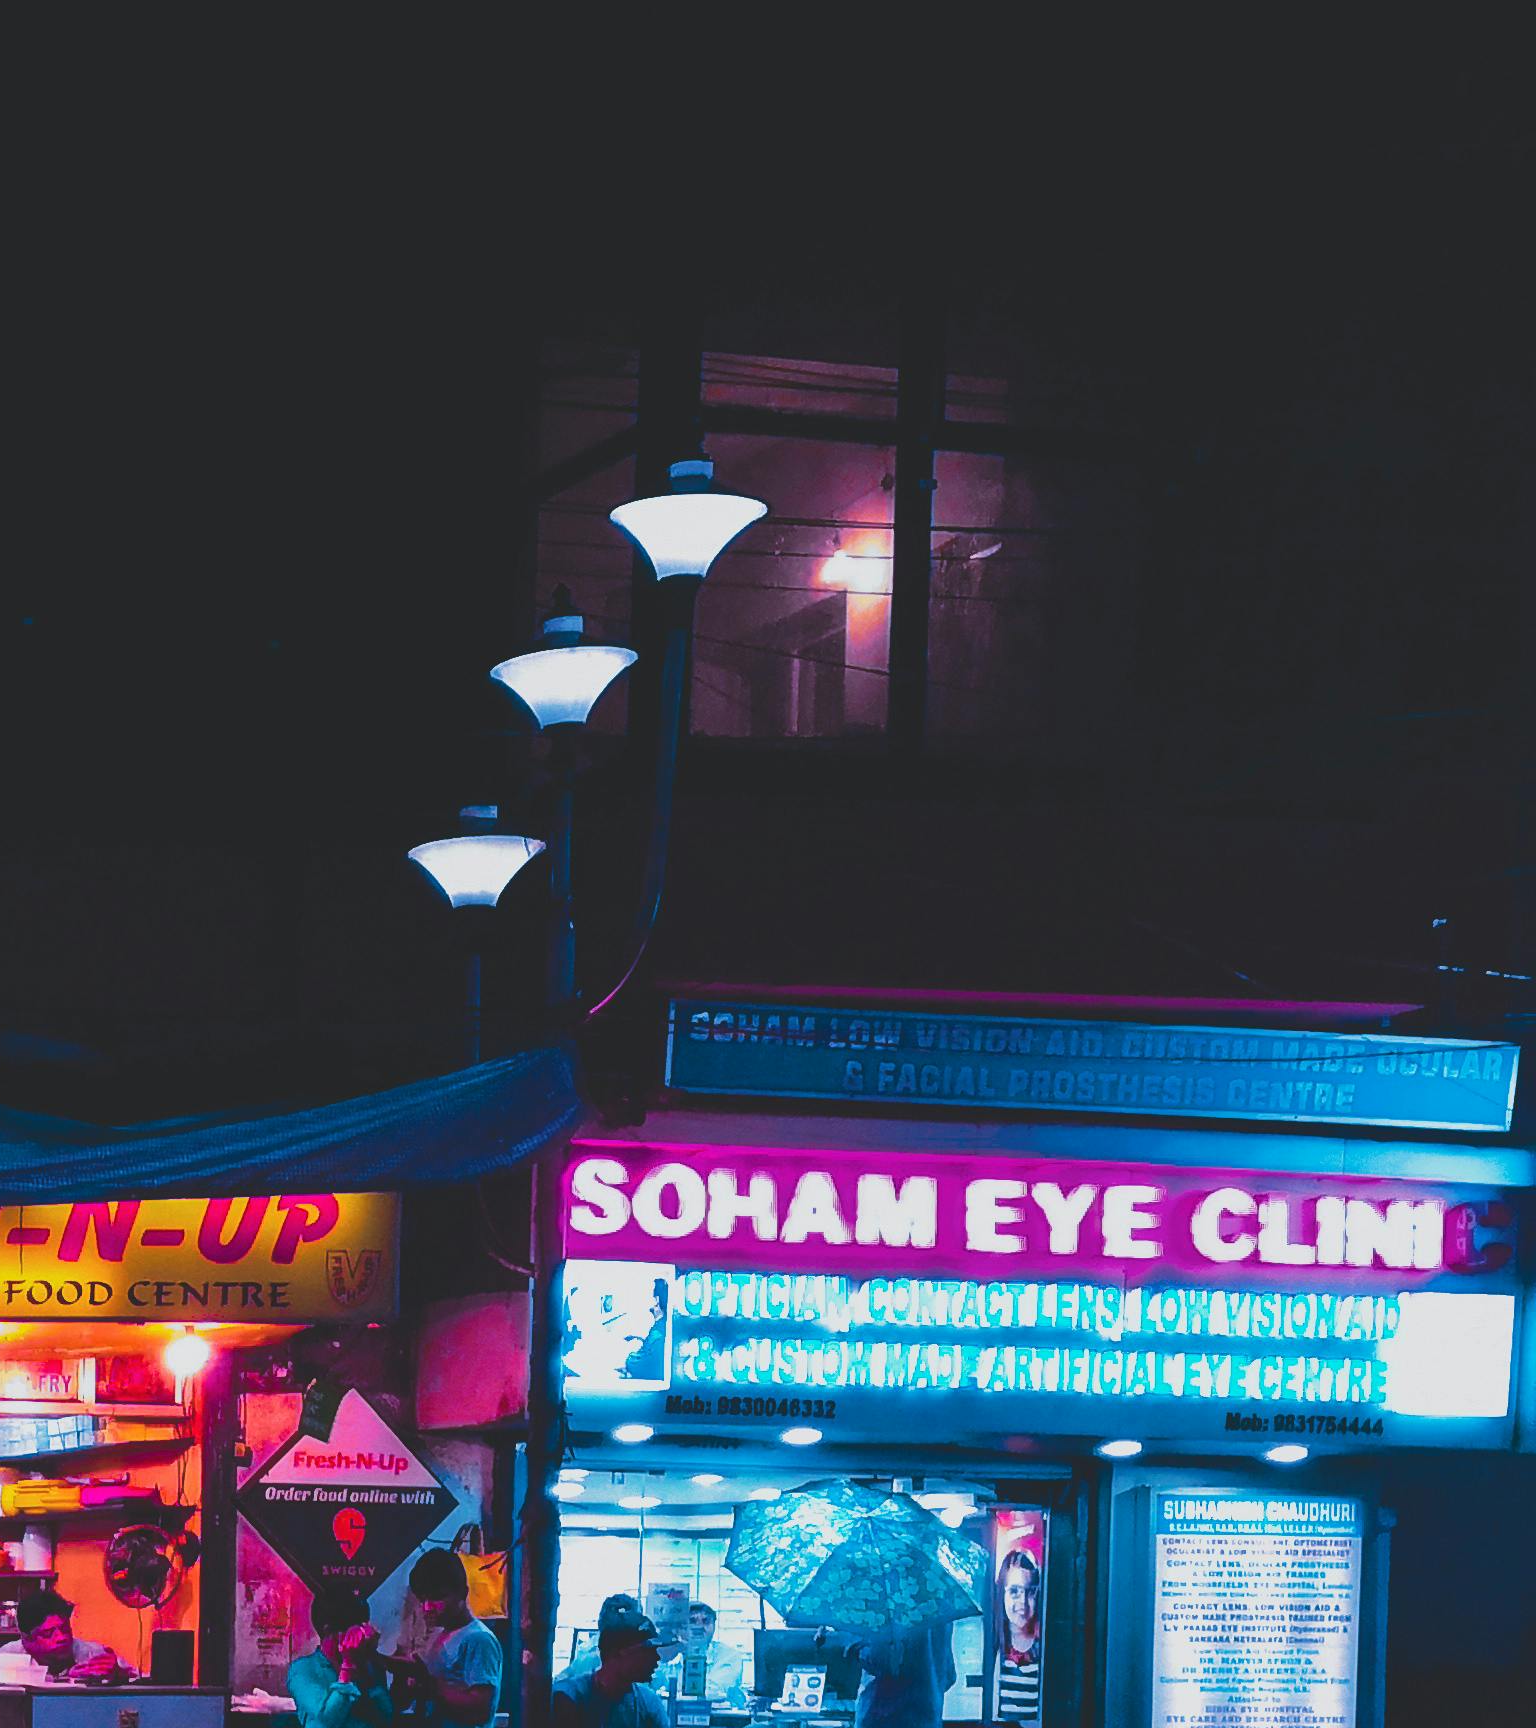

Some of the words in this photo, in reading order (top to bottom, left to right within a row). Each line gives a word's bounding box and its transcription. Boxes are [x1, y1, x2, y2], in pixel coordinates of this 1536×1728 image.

[690, 1011, 816, 1047] SOHAM
[829, 1018, 903, 1051] LOW
[917, 1023, 1033, 1055] VISION
[1272, 1040, 1366, 1074] MADE
[1375, 1047, 1503, 1081] OCULAR
[878, 1062, 996, 1098] FACIAL
[1008, 1068, 1214, 1105] PROSTHESIS
[1227, 1079, 1356, 1113] CENTRE
[569, 1158, 939, 1249] SOHAM
[965, 1178, 1166, 1260] EYE
[4, 1277, 113, 1308] FOOD
[128, 1279, 291, 1310] CENTRE
[866, 1278, 1027, 1327] CONTACT
[1136, 1288, 1211, 1335] LOW
[1223, 1291, 1340, 1338] VISION
[1344, 1295, 1402, 1341] AID
[690, 1336, 715, 1382] &
[732, 1338, 876, 1386] CUSTOM
[883, 1343, 981, 1390] MADE
[988, 1347, 1171, 1396] ARTIFICIAL
[1182, 1354, 1245, 1400] EYE
[1256, 1356, 1389, 1404] CENTRE
[293, 1451, 409, 1475] Fresh-N-Up
[265, 1486, 311, 1502] Order
[313, 1487, 348, 1503] food
[350, 1489, 398, 1504] online
[400, 1491, 436, 1505] with
[321, 1566, 376, 1577] SWIGGY
